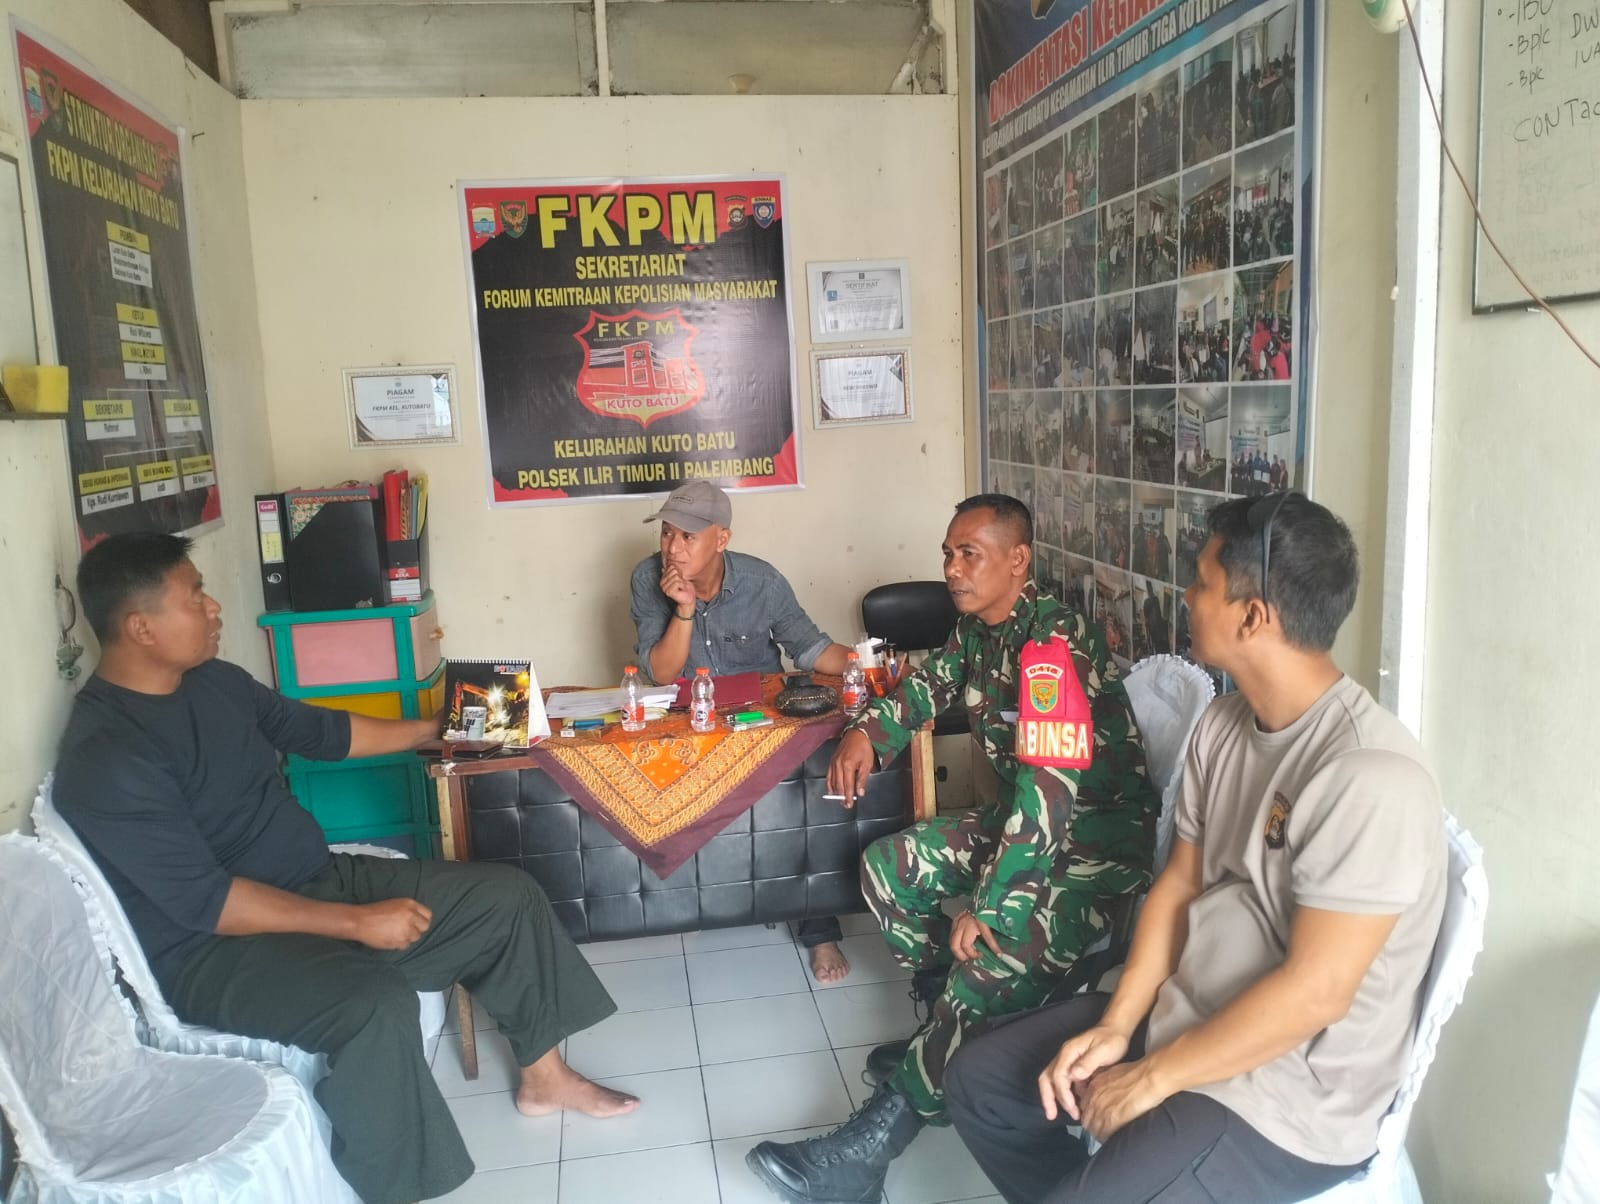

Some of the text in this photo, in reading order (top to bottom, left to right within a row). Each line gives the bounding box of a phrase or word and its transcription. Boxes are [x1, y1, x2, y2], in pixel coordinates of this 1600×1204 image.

[990, 5, 1088, 127] DOKUMENTASI
[983, 121, 1015, 159] KELURAHAN
[1050, 63, 1097, 116] KECAMATAN
[1097, 49, 1116, 86] ILIR
[1116, 28, 1150, 73] TIMUR
[1150, 8, 1177, 51] TIGA
[64, 91, 117, 158] STRUKTUR
[46, 139, 180, 231] FKPM KELURAHAN KUTO BATU
[537, 193, 717, 249] FKPM
[575, 254, 687, 280] SEKRETARIAT
[484, 280, 778, 309] FORUM KEMITRAAN KEPOLISIAN MASYARAKAT
[598, 321, 675, 338] FKPM
[607, 397, 680, 410] KUTO BATU
[554, 431, 736, 459] KELURAHAN KUTO BATU
[518, 456, 775, 488] POLSEK ILIR TIMUR II PALEMBANG
